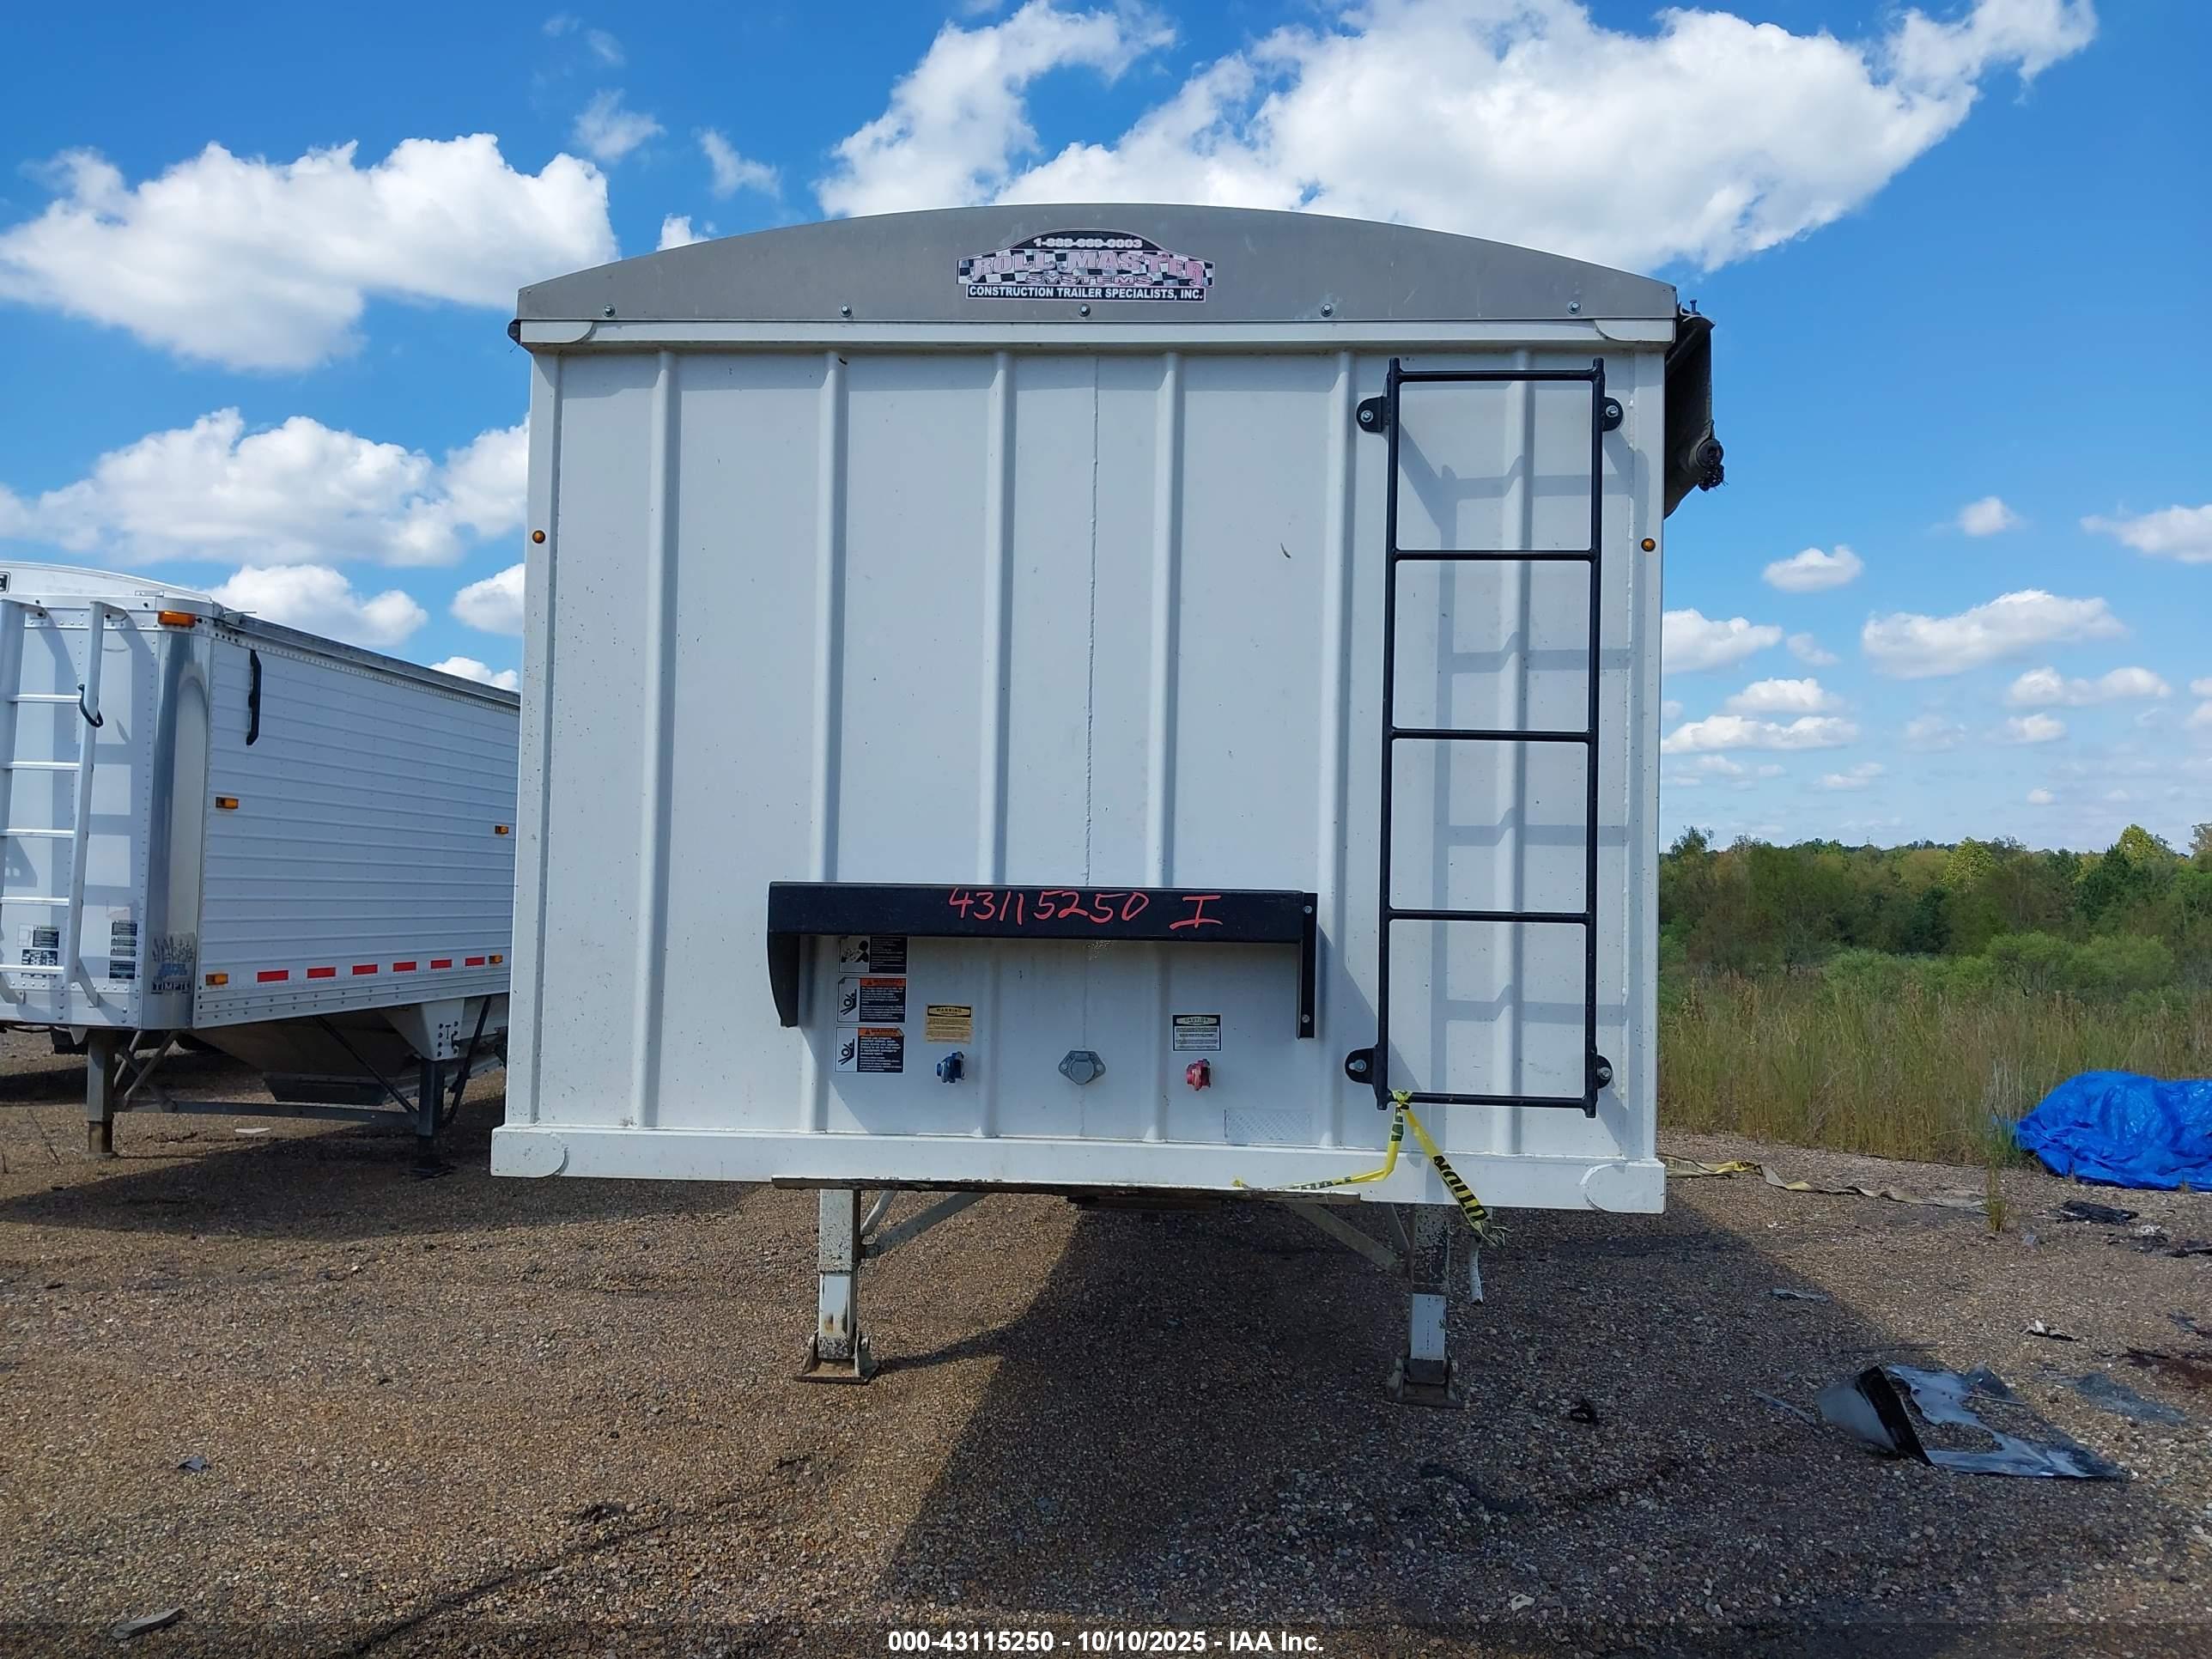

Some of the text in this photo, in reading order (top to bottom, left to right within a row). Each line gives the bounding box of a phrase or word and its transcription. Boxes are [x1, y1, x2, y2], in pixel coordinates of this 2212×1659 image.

[969, 251, 1204, 286] ROLL MASTER
[1025, 275, 1154, 285] SYSTEMS
[969, 286, 1203, 301] CONSTRUCTION TRAILER SPECIALISTS, INC.
